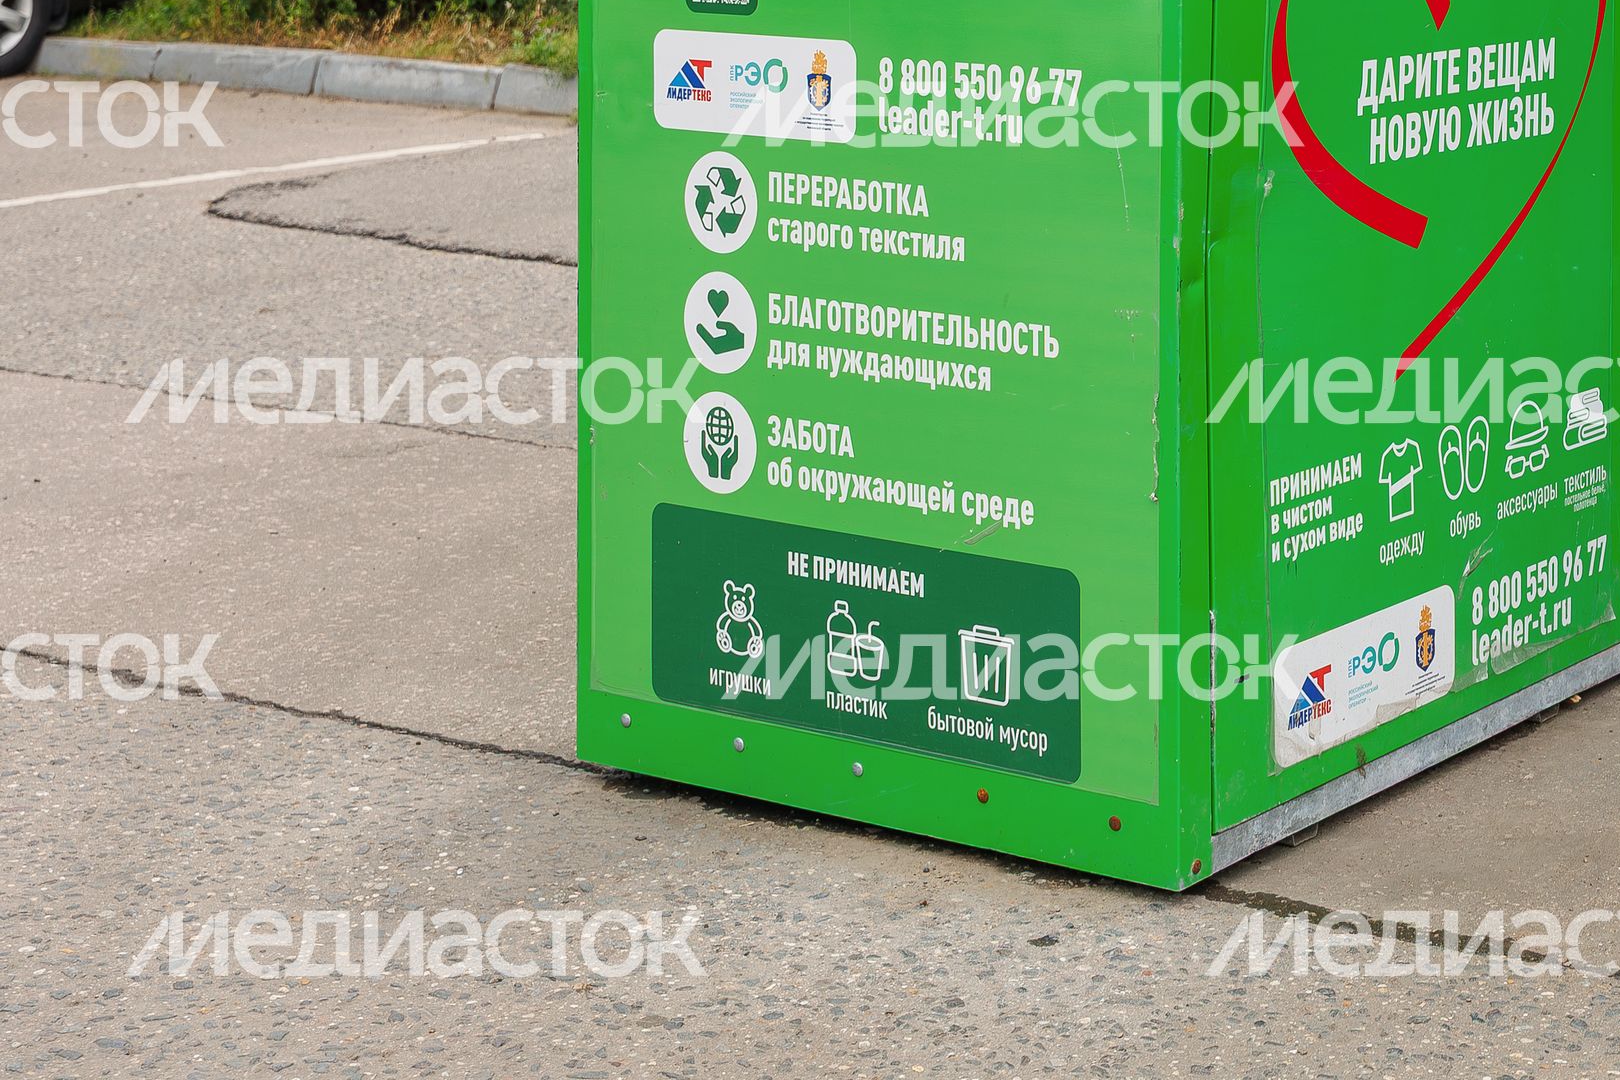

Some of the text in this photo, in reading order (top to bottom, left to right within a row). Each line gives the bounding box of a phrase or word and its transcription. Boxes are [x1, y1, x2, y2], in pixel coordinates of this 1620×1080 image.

[667, 87, 712, 102] ЛИДЕРТЕКС
[879, 57, 1083, 107] 8 800 550 96 77
[1357, 37, 1556, 116] ДАРИТЕ ВЕЩАМ
[878, 96, 1023, 146] leader-t.ru
[1369, 92, 1554, 164] НОВУЮ ЖИЗНЬ
[767, 170, 929, 217] ПЕРЕРАБОТКА
[767, 217, 965, 262] старого текстиля
[767, 292, 1059, 359] БЛАГОТВОРИТЕЛЬНОСТЬ
[767, 339, 991, 392] для нуждающихся
[767, 414, 854, 459] ЗАБОТА
[767, 456, 1035, 529] об окружающей среде
[1269, 452, 1362, 507] ПРИНИМАЕМ
[1497, 484, 1558, 521] аксессуары
[1564, 465, 1607, 495] текстиль
[1271, 514, 1363, 563] и сухом виде
[1379, 529, 1425, 565] одежду
[1449, 512, 1481, 539] обувь
[787, 550, 925, 599] НЕ ПРИНИМАЕМ
[1472, 535, 1608, 626] 8 800 550 96 77
[1471, 595, 1573, 666] leader-t.ru
[709, 666, 772, 697] игрушки
[826, 690, 888, 722] пластик
[927, 705, 1048, 758] бытовой мусор
